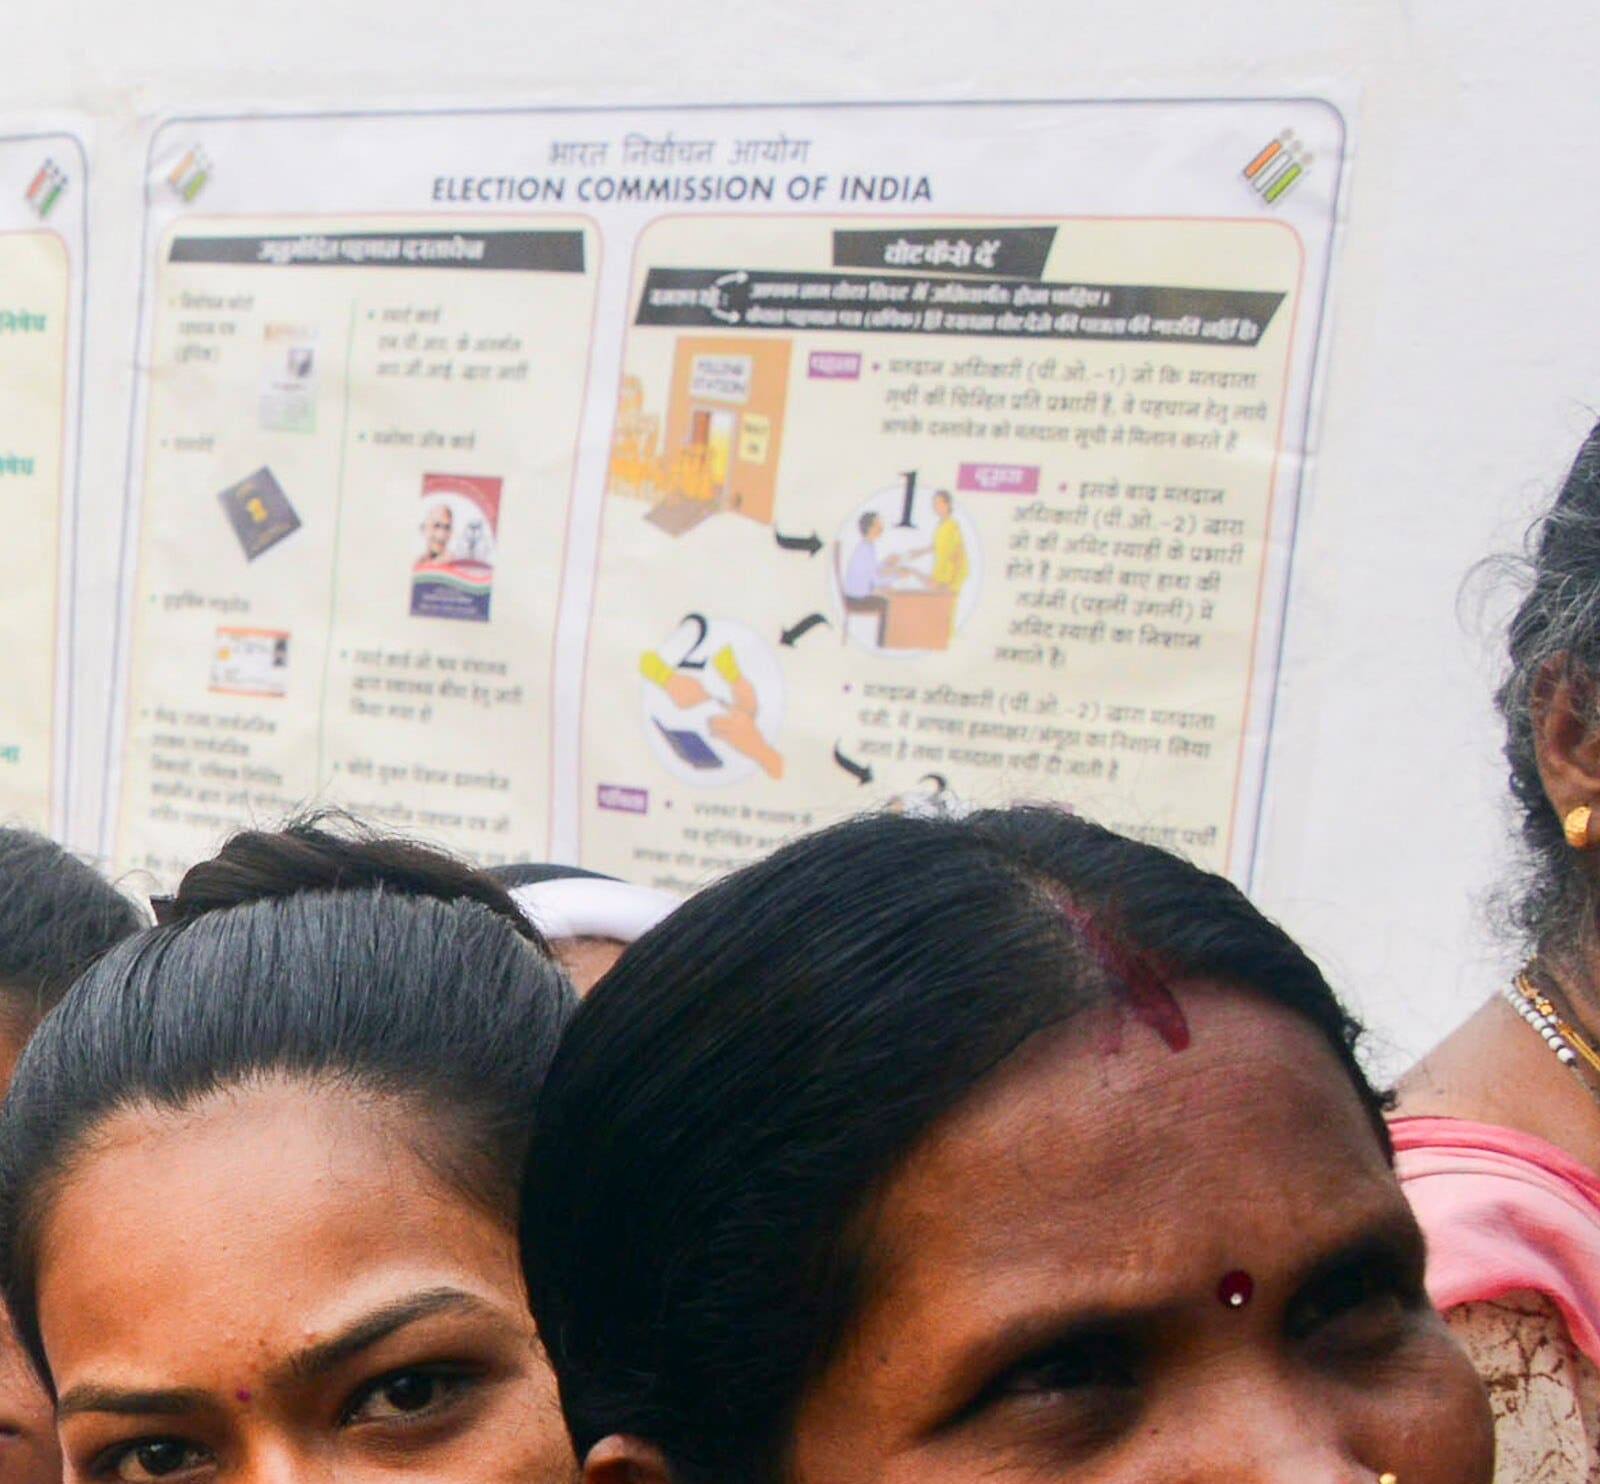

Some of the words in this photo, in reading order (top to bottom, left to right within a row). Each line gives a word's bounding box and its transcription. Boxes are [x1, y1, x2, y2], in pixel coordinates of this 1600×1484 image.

[549, 138, 612, 166] भारत
[621, 132, 715, 165] निर्वाचन
[731, 132, 813, 164] आयोग
[431, 175, 566, 202] ELECTION
[577, 175, 776, 202] COMMISSION
[787, 175, 828, 201] OF
[839, 175, 934, 202] INDIA
[679, 612, 711, 669] 2
